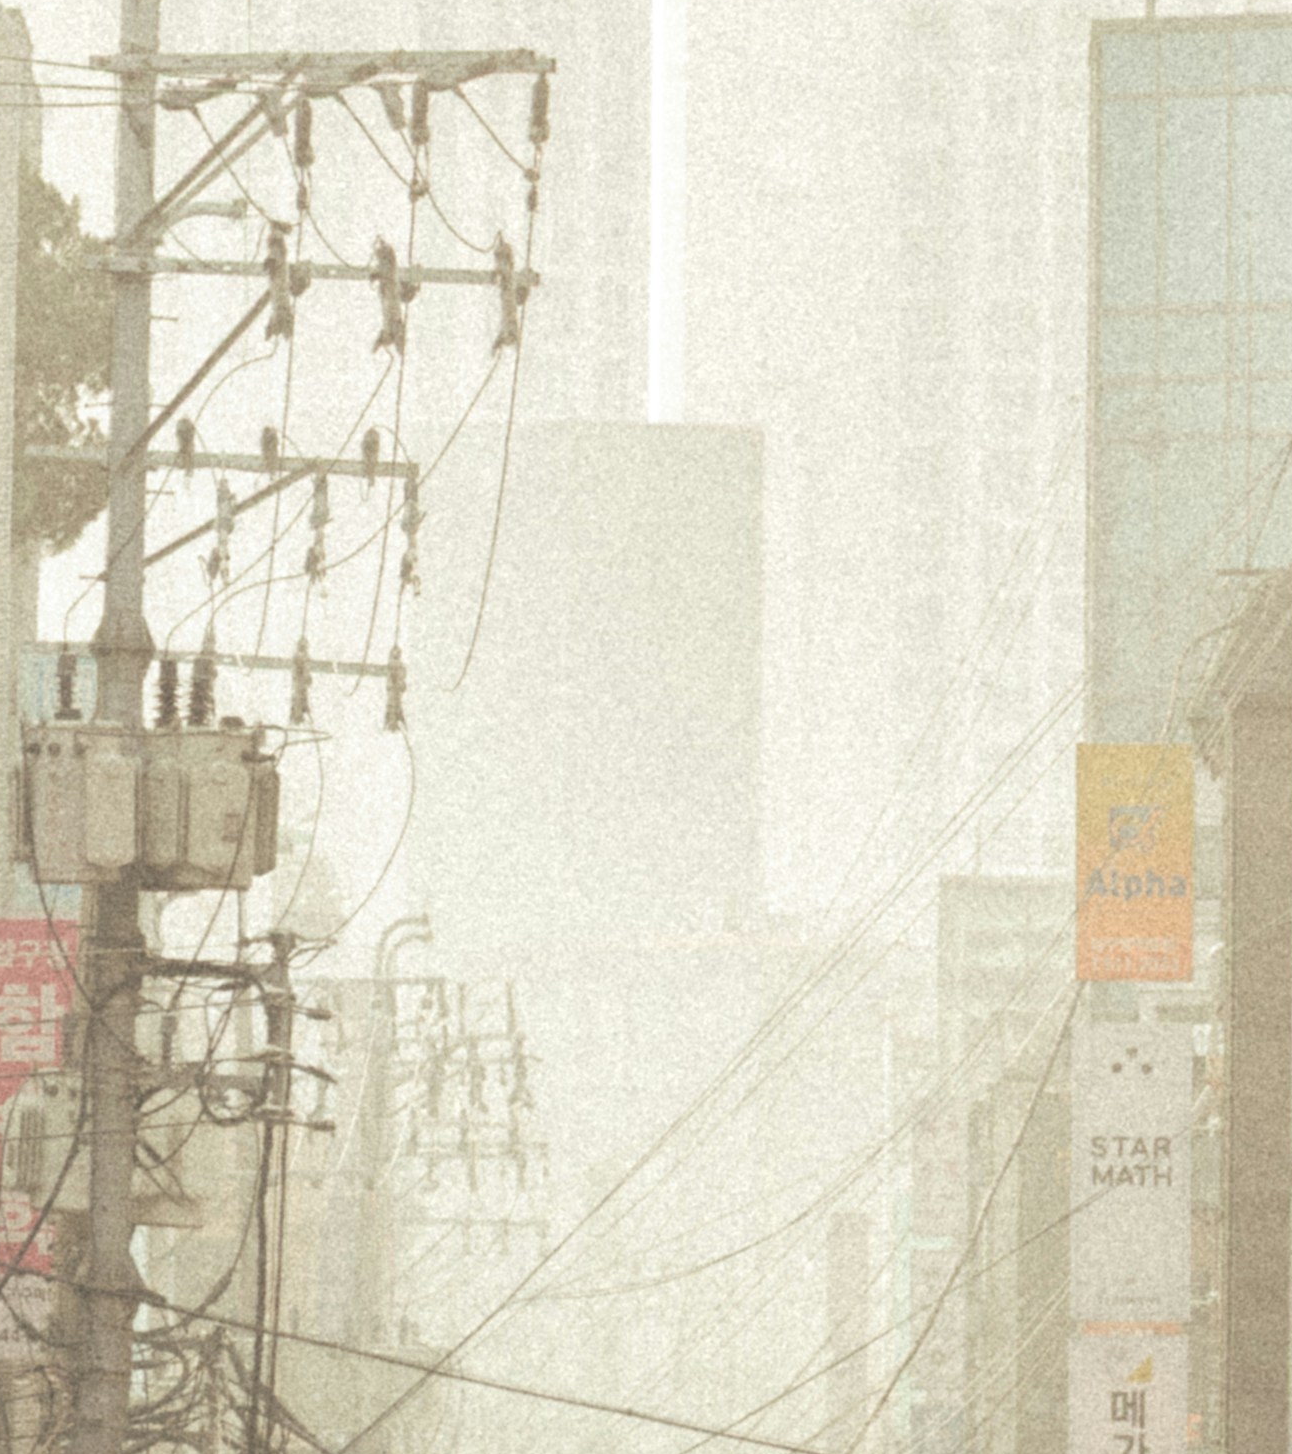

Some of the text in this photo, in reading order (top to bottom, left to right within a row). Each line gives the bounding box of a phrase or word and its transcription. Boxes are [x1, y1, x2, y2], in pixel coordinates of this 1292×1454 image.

[1085, 867, 1188, 903] Alpha
[1091, 1136, 1172, 1159] STAR
[1091, 1163, 1173, 1188] MATH
